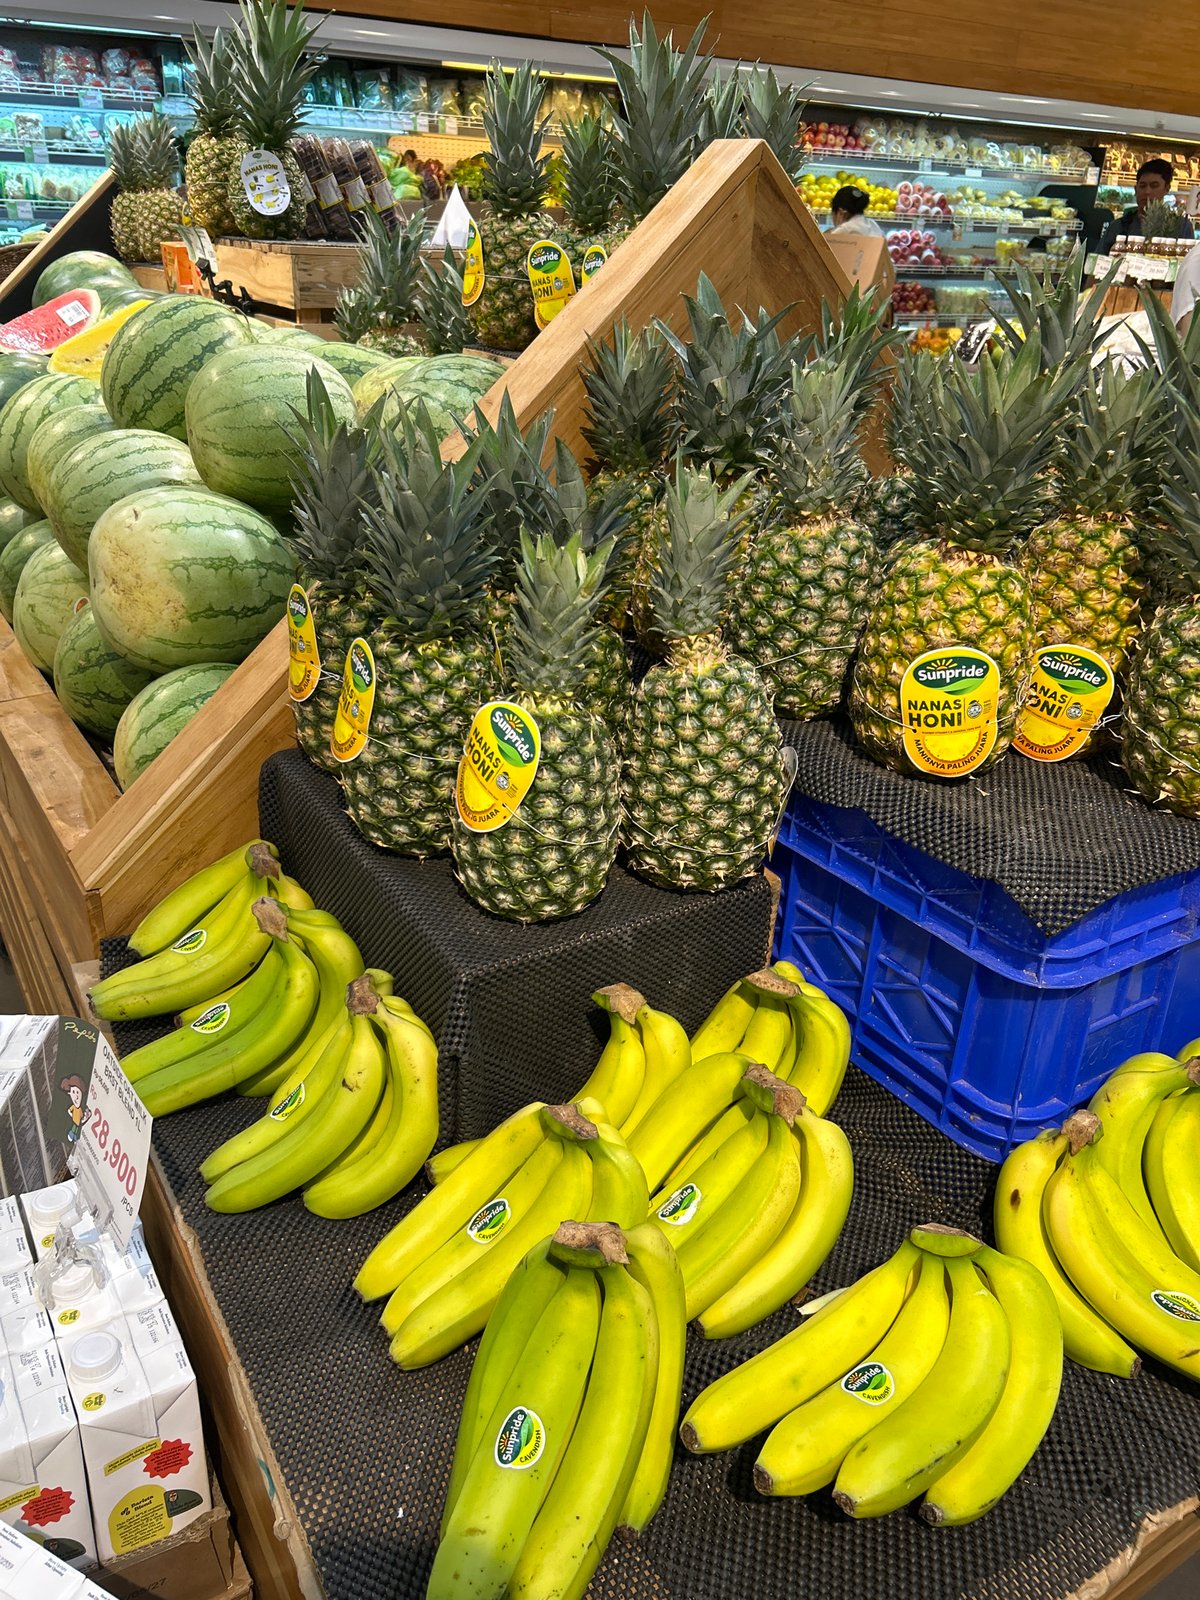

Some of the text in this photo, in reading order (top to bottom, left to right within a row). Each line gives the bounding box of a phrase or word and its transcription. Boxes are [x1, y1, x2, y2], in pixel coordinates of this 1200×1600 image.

[244, 164, 263, 177] NANAS
[530, 251, 559, 266] Sunpride
[917, 664, 985, 684] Sunpride
[1041, 655, 1101, 686] Sunpride
[907, 699, 962, 712] NANAS
[1030, 681, 1068, 704] ANAS
[908, 711, 962, 728] HONI
[1027, 694, 1063, 719] ONI
[472, 727, 502, 769] NANAS
[492, 710, 531, 761] Sunpride
[1025, 735, 1076, 755] PALING JUARA
[466, 737, 495, 783] HONI
[914, 731, 989, 770] MANISNYA PALING JUARA
[478, 808, 501, 823] JUARA
[118, 1087, 135, 1120] BLEND
[135, 1116, 142, 1133] 1L
[91, 1107, 137, 1196] 28,900
[662, 1188, 693, 1216] Sunpride
[471, 1204, 505, 1231] Sunpride
[847, 1366, 882, 1391] Sunpride
[862, 1385, 890, 1401] CAVENDISH
[502, 1413, 525, 1462] Sunpride
[519, 1429, 541, 1463] CAVENDISH
